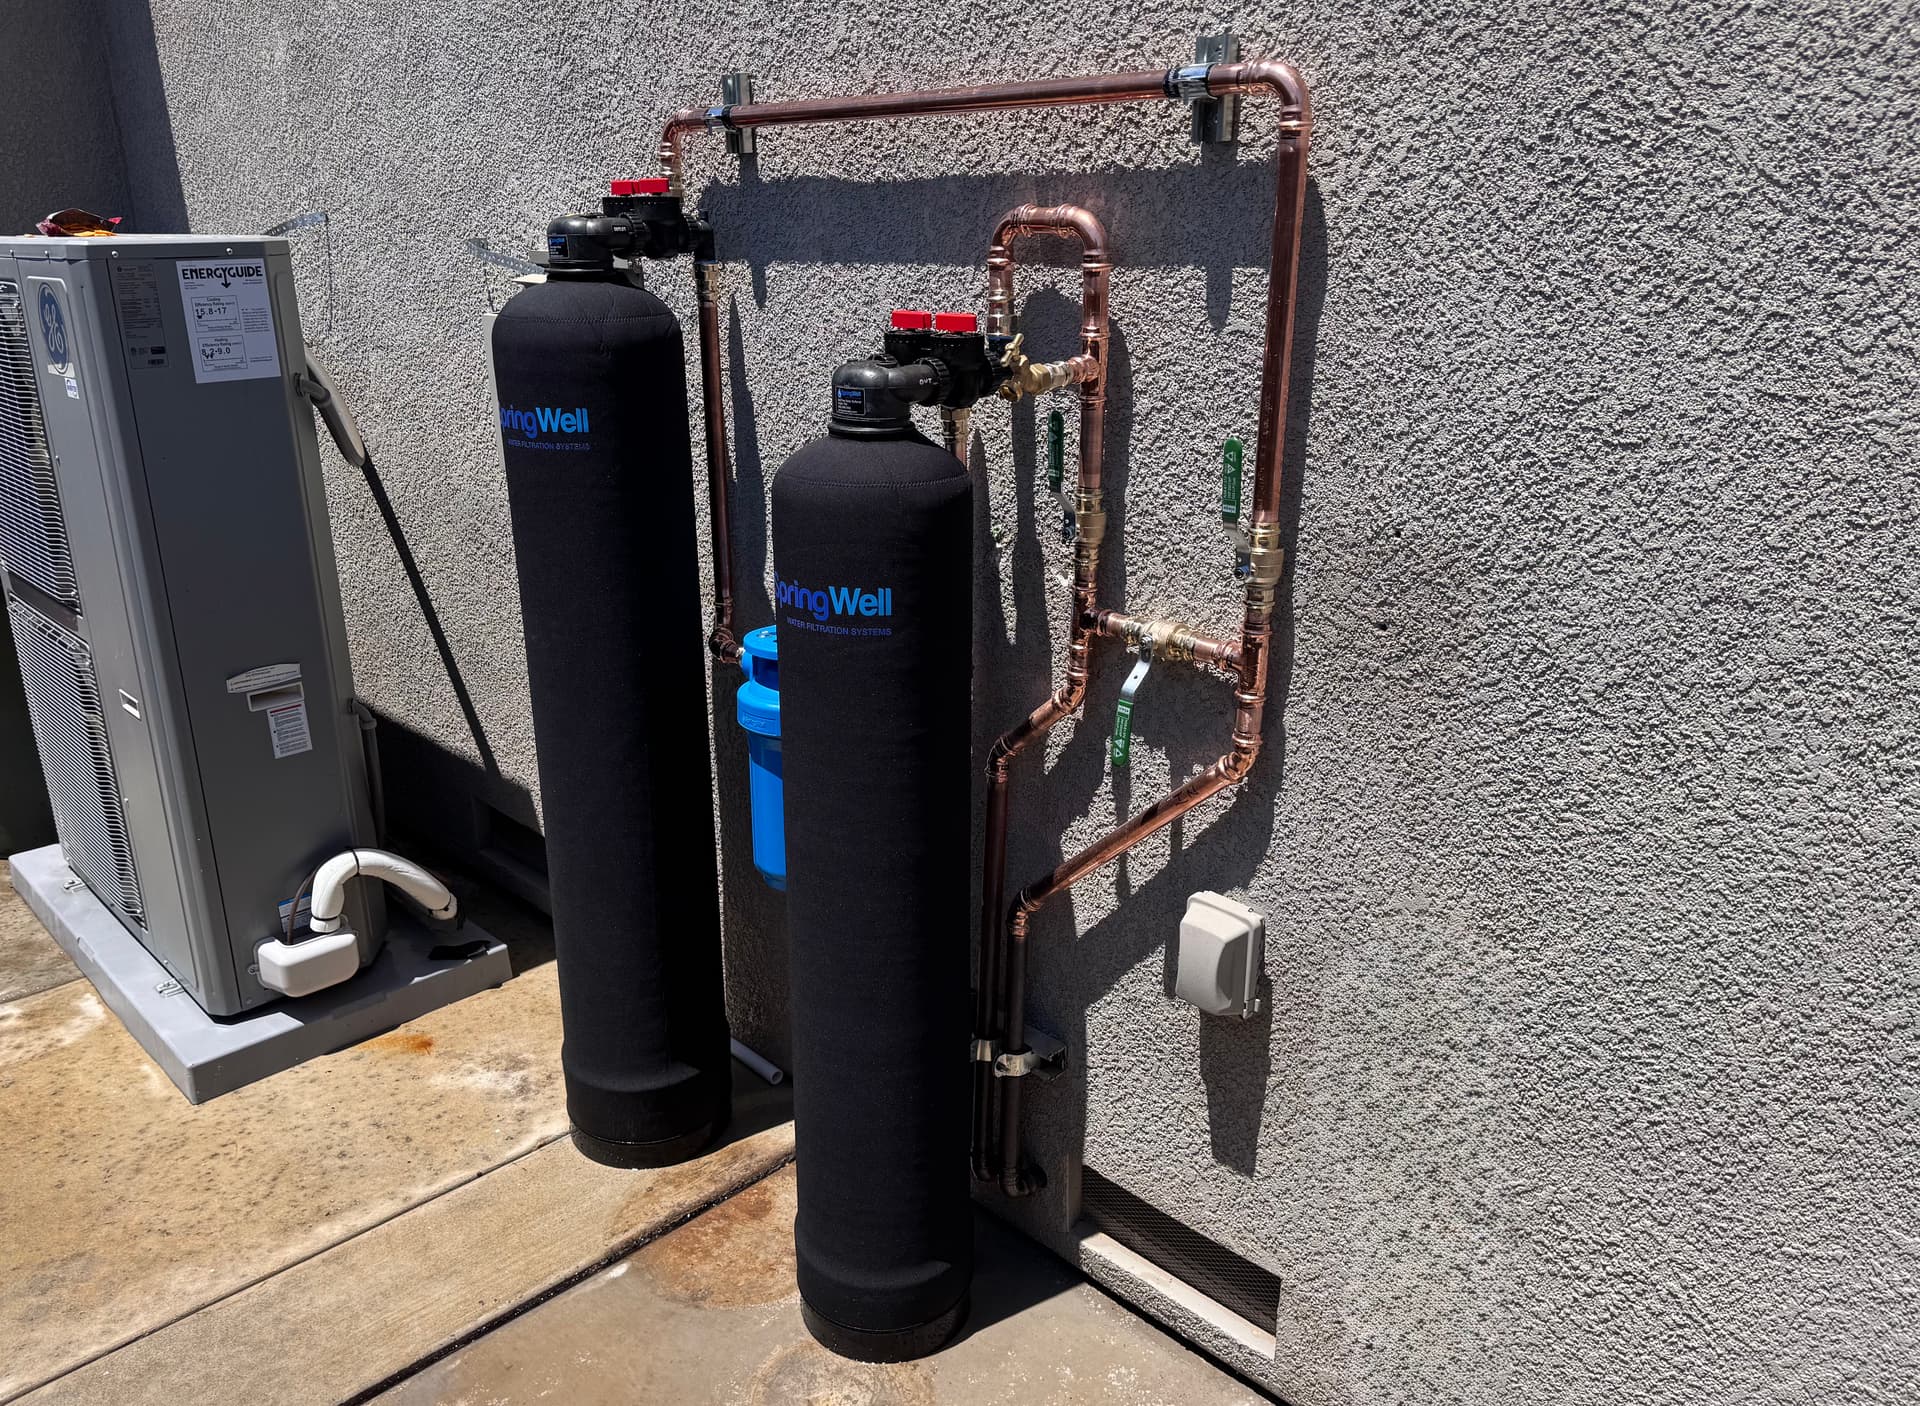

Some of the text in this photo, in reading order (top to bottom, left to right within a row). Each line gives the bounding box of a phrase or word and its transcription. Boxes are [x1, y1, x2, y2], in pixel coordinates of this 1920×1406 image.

[182, 266, 263, 280] ENERGYGUIDE
[500, 404, 589, 439] pringWell
[807, 621, 849, 636] FILTRATION
[851, 626, 892, 637] SYSTEMS
